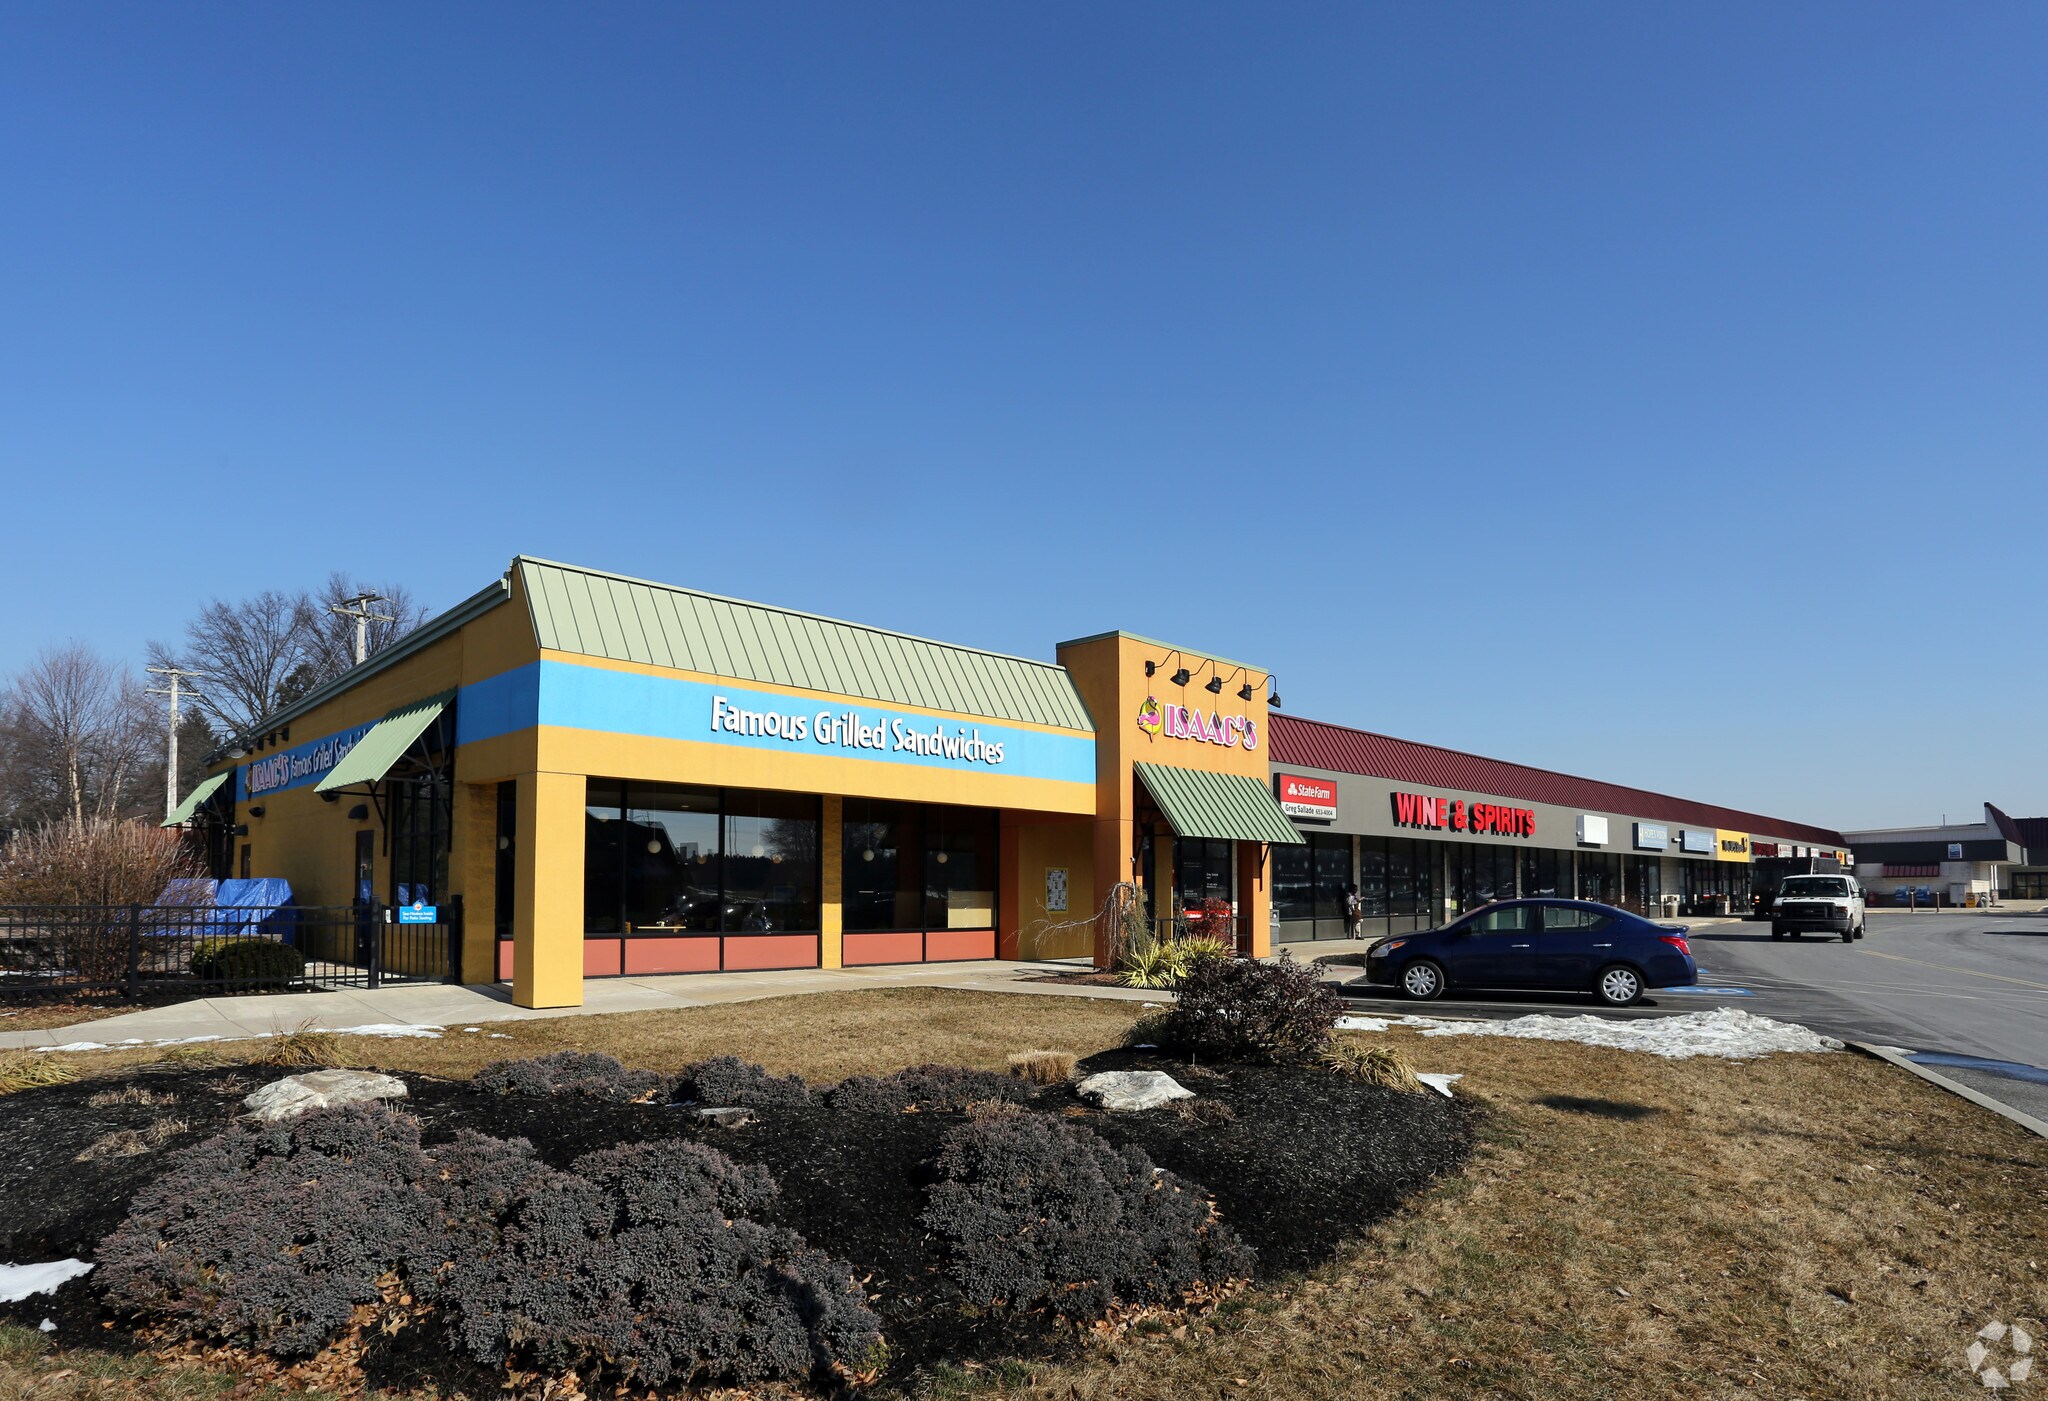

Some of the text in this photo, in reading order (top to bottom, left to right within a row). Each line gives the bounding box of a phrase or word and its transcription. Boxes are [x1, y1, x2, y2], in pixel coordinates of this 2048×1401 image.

[711, 695, 1004, 765] Famous Grilled Sandwiches
[1164, 703, 1258, 750] ISAAC'S
[291, 755, 312, 779] Famous
[313, 741, 333, 773] Grilled
[1285, 803, 1297, 814] Greg
[1393, 791, 1536, 837] WINE & SPIRITS
